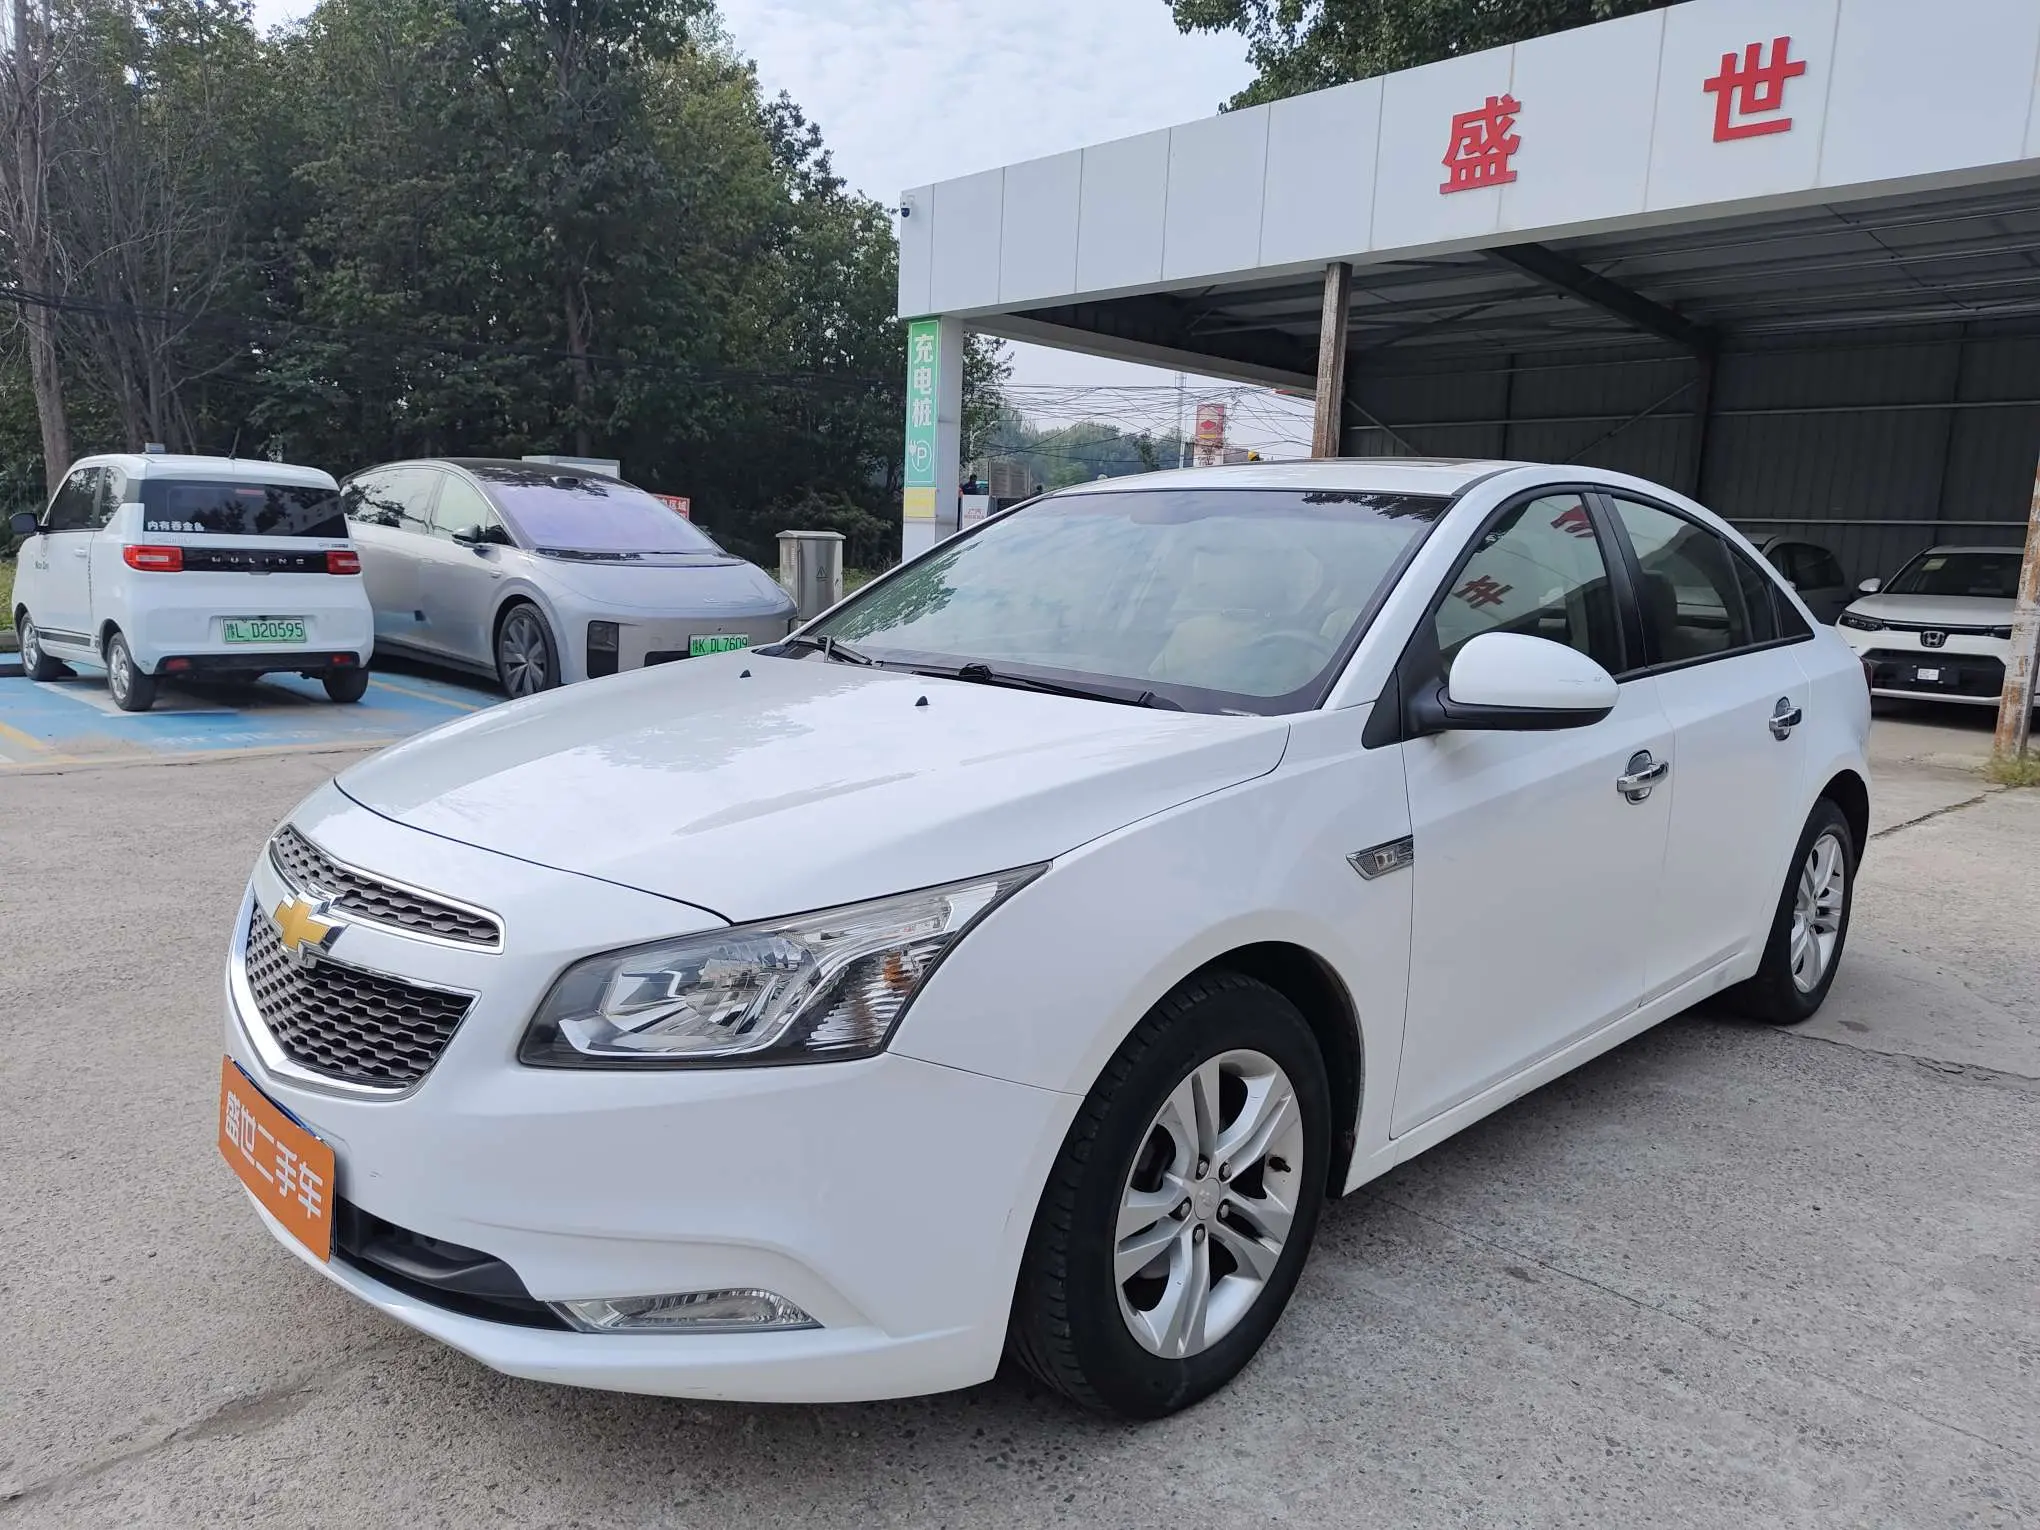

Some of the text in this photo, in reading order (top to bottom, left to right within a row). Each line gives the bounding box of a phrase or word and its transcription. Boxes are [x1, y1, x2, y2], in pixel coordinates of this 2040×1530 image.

[1440, 36, 1806, 194] 盛世
[911, 333, 935, 428] 充电桩
[225, 1090, 323, 1219] 盛世二手车
